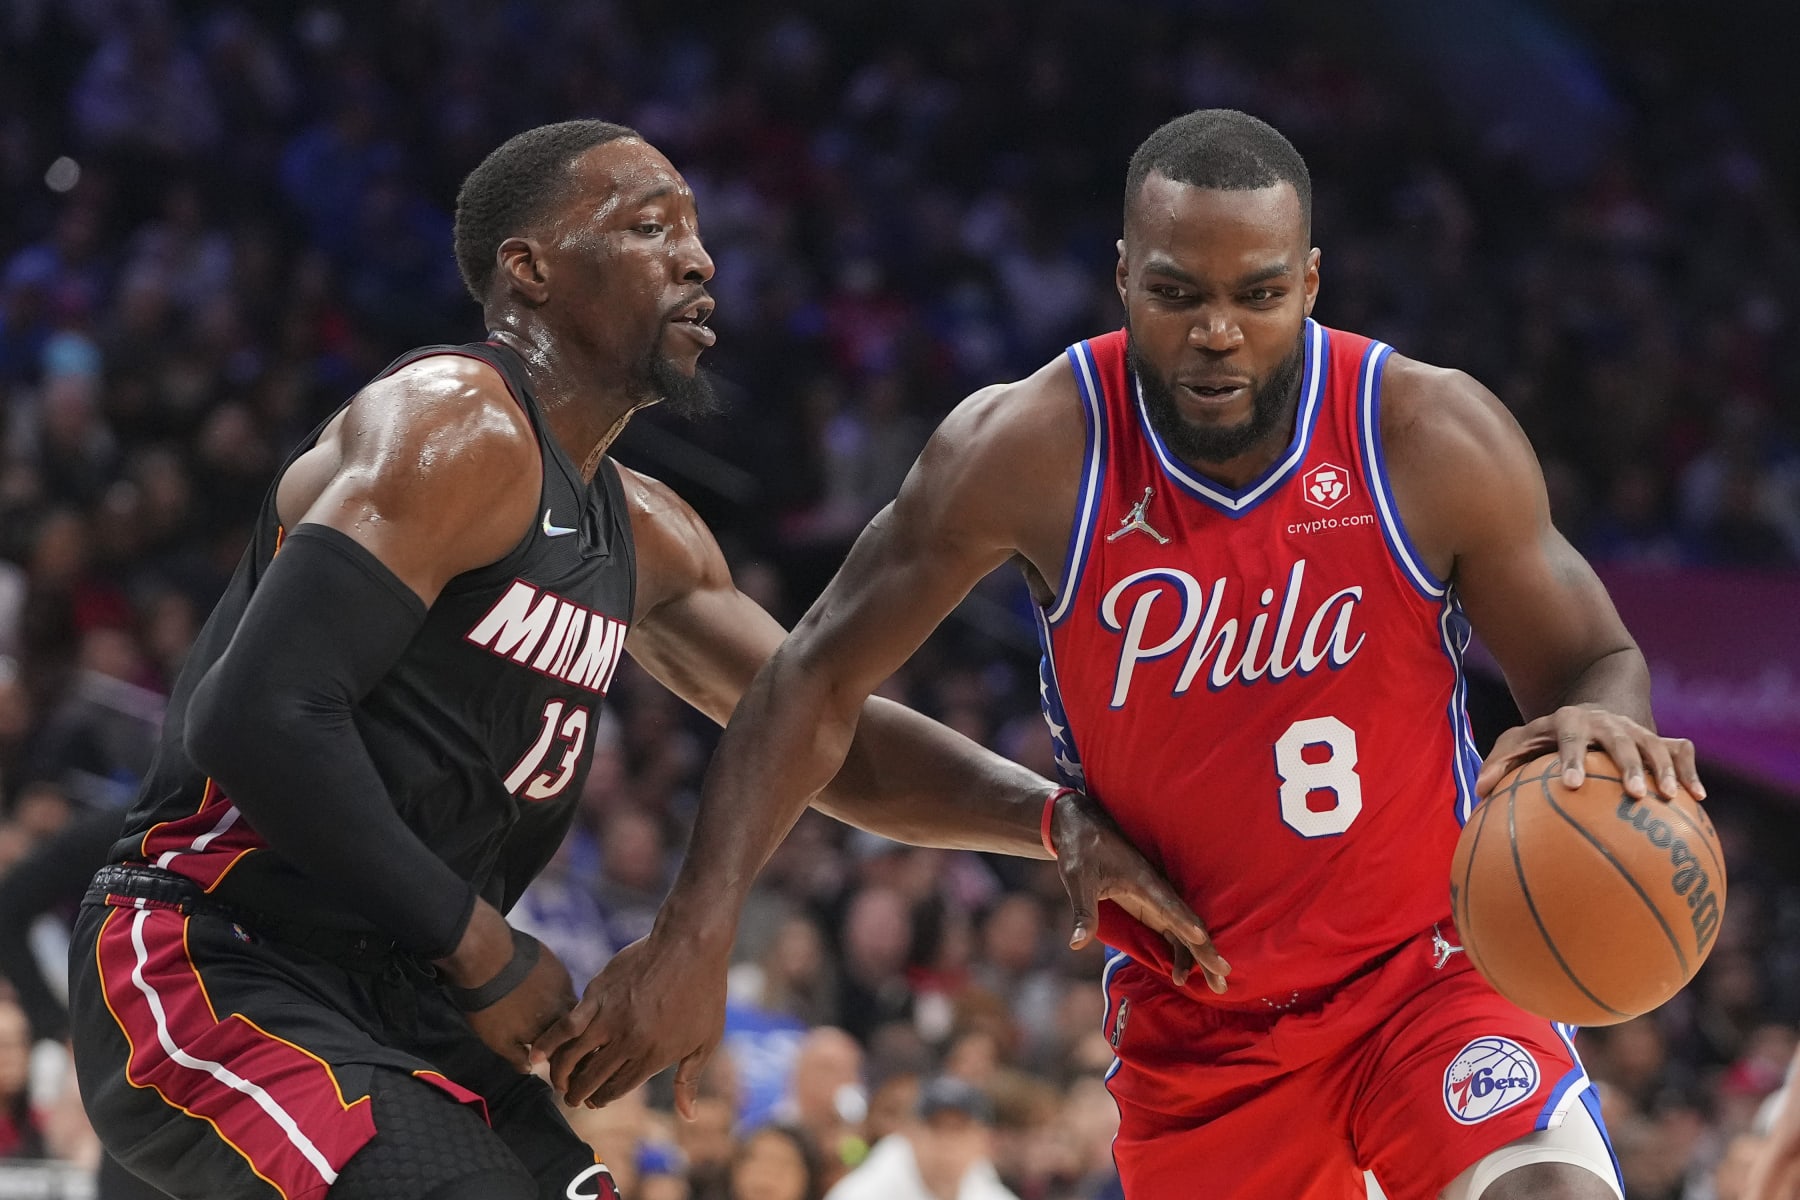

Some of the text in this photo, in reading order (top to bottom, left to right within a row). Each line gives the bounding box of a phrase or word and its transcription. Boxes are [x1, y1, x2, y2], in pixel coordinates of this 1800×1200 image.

[1287, 514, 1374, 534] crypto.com
[464, 577, 628, 697] MIAMI
[1098, 559, 1366, 710] Phila
[501, 698, 589, 802] 13
[1272, 715, 1363, 841] 8
[1452, 1067, 1530, 1113] 76ers
